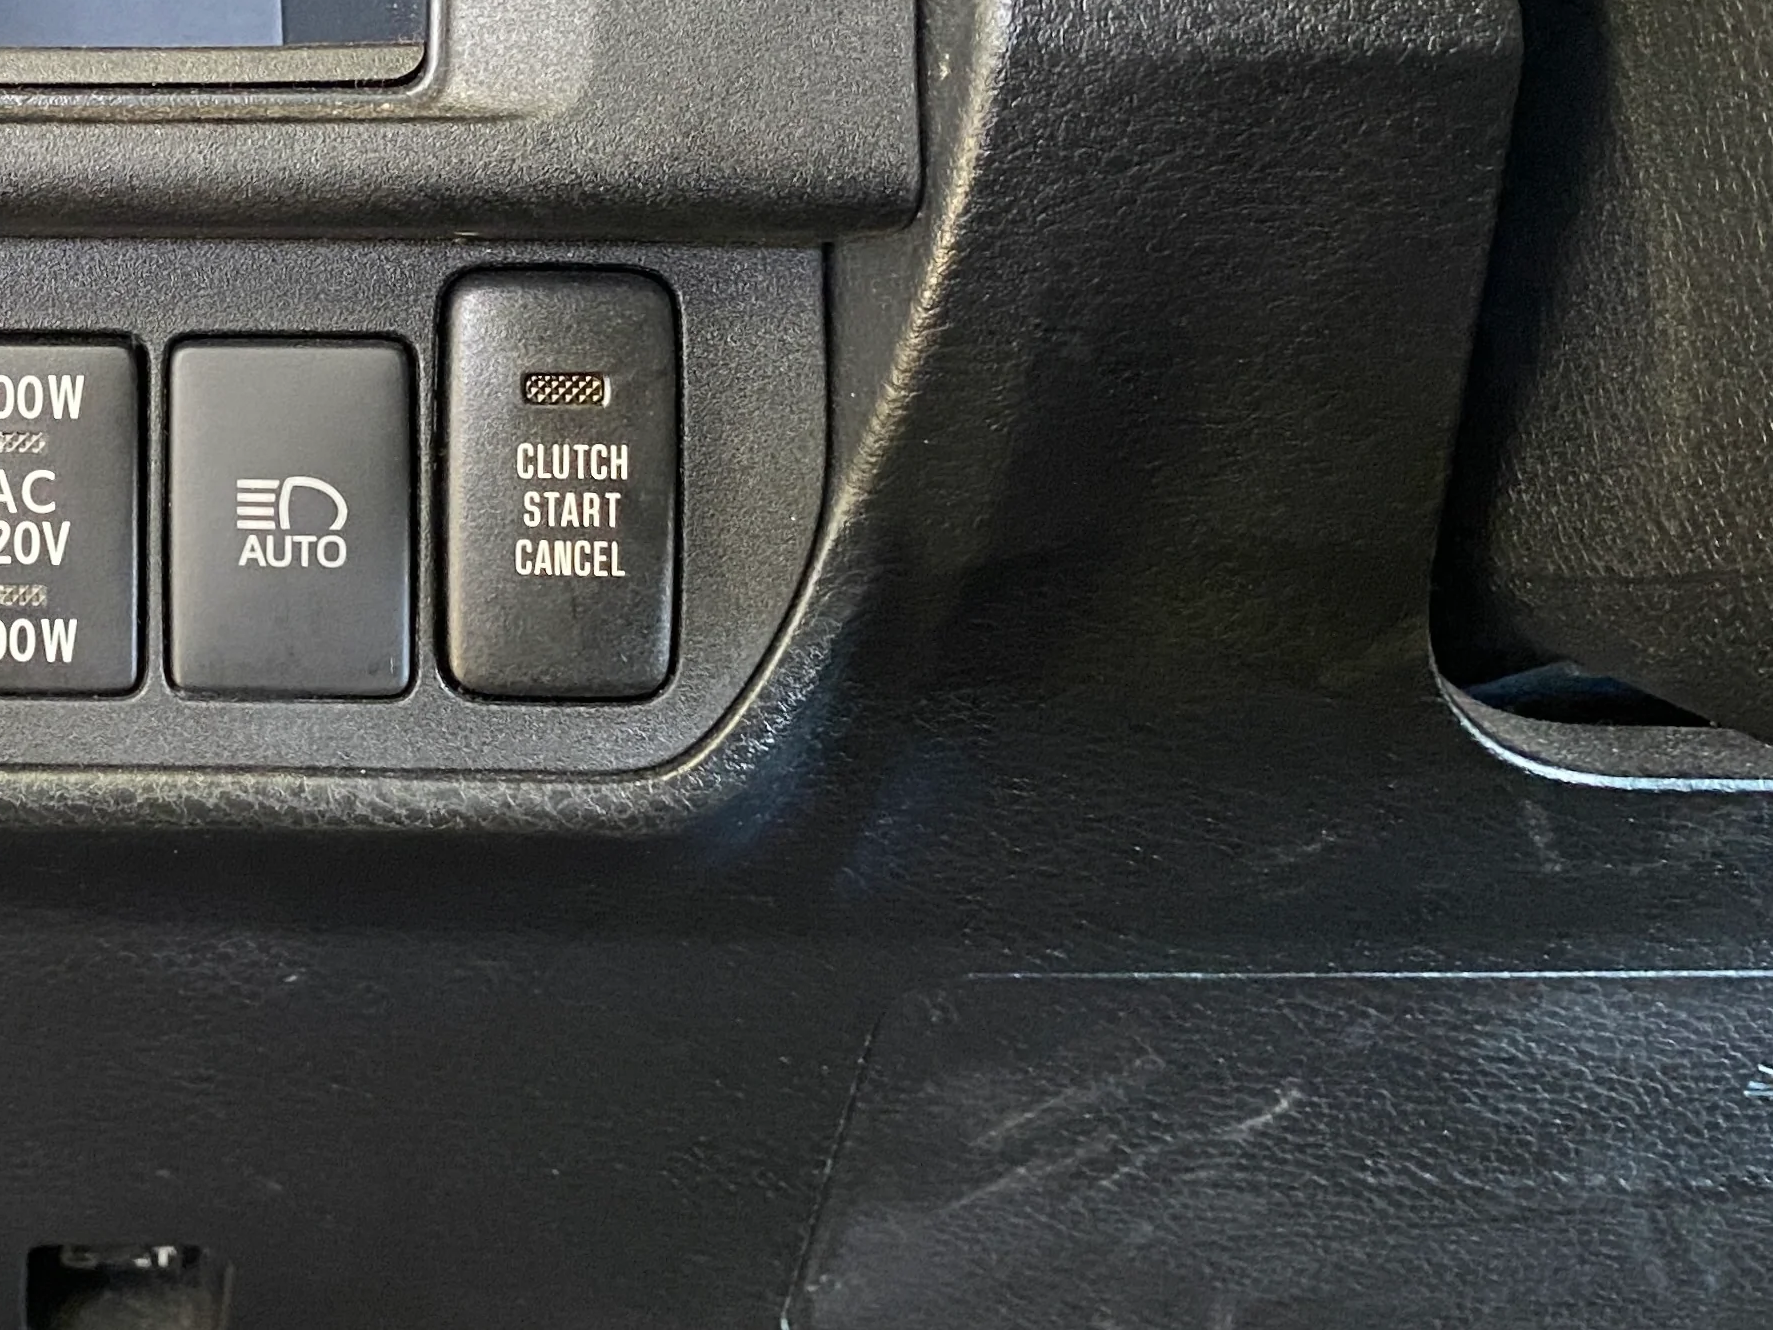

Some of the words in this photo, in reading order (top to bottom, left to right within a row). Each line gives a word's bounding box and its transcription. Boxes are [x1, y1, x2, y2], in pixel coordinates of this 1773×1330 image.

[515, 442, 628, 481] CLUTCH
[523, 490, 621, 528] START
[238, 534, 347, 568] AUTO
[514, 538, 626, 578] CANCEL
